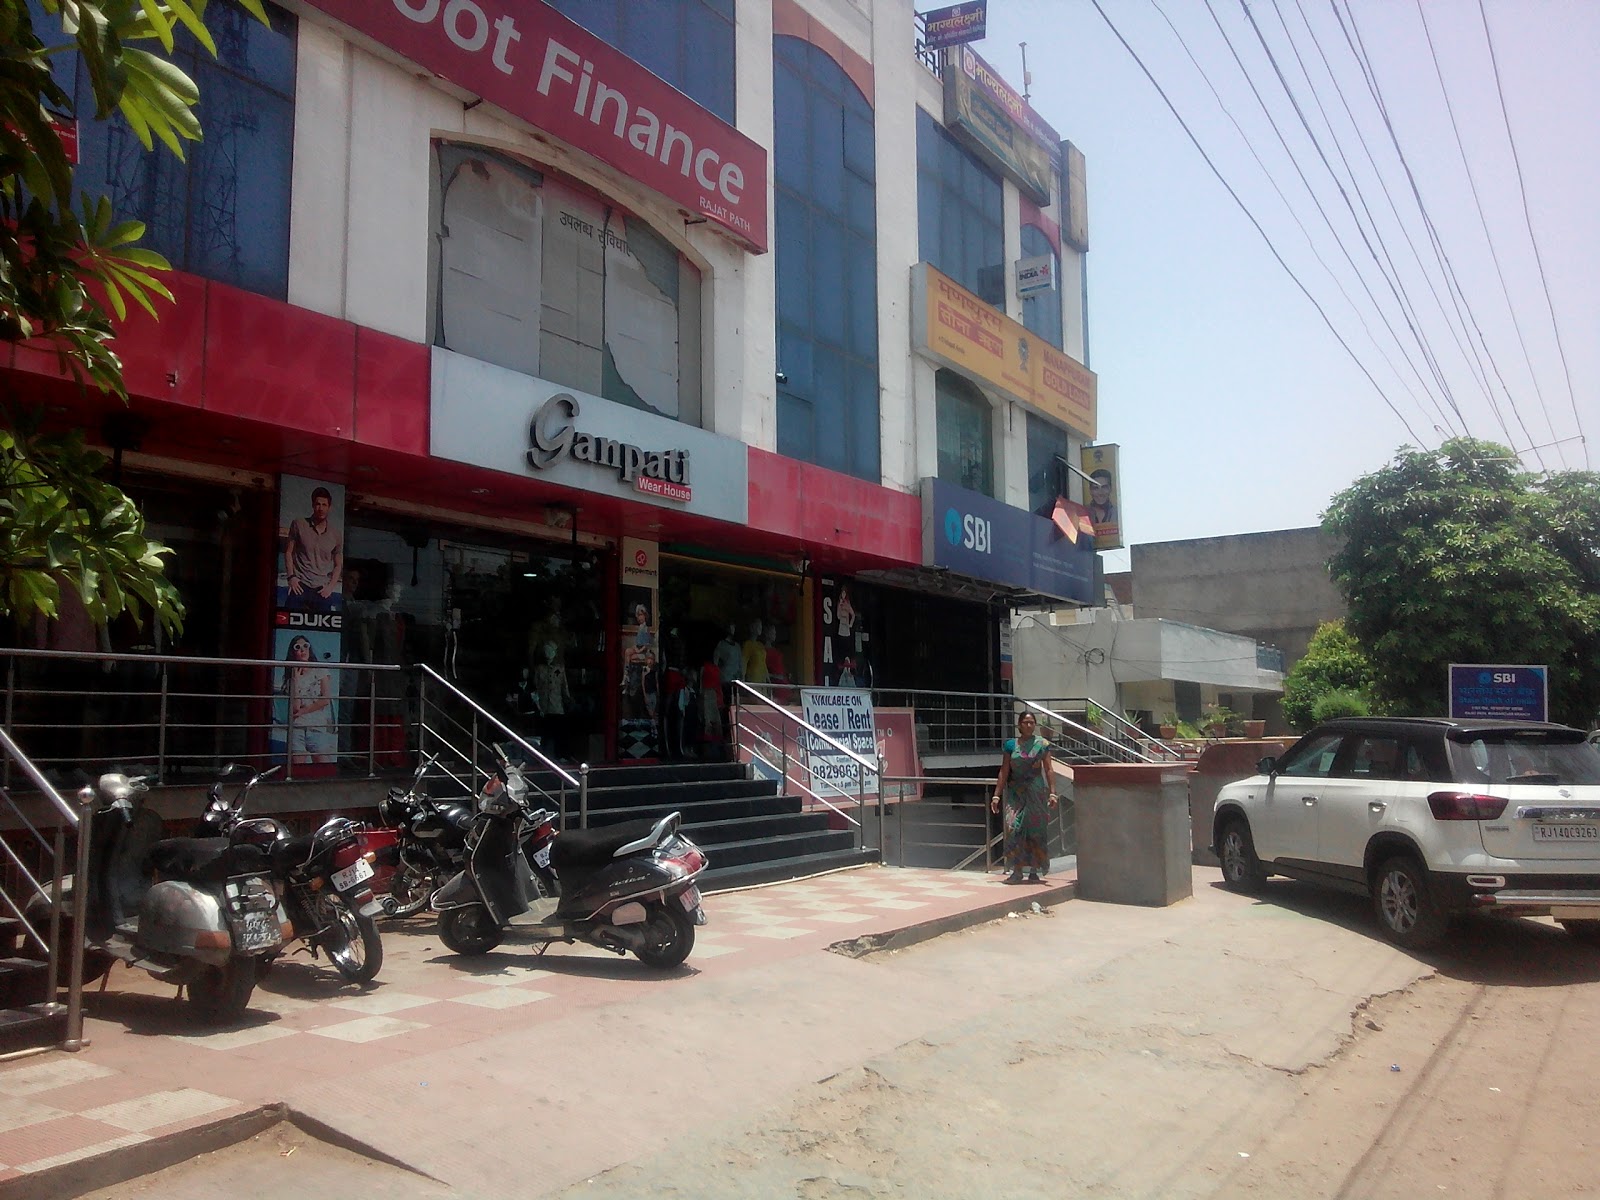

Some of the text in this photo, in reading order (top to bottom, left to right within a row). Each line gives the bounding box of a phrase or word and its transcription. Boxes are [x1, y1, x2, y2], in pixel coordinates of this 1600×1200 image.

[536, 38, 744, 204] Finance
[560, 210, 594, 238] उपलब्ध
[700, 196, 750, 232] RAJAT PATH
[940, 307, 971, 336] सोना
[1045, 370, 1068, 394] GOLD
[526, 392, 691, 485] Ganpati
[638, 476, 691, 500] Wear House
[964, 514, 991, 554] SBI
[290, 612, 342, 628] DUKE
[1494, 673, 1516, 684] SBI
[811, 695, 862, 706] AVAILABLE ON
[806, 706, 839, 730] Lease
[847, 708, 872, 730] Rent
[852, 734, 873, 753] Space
[1542, 827, 1598, 838] RJ14QC9263
